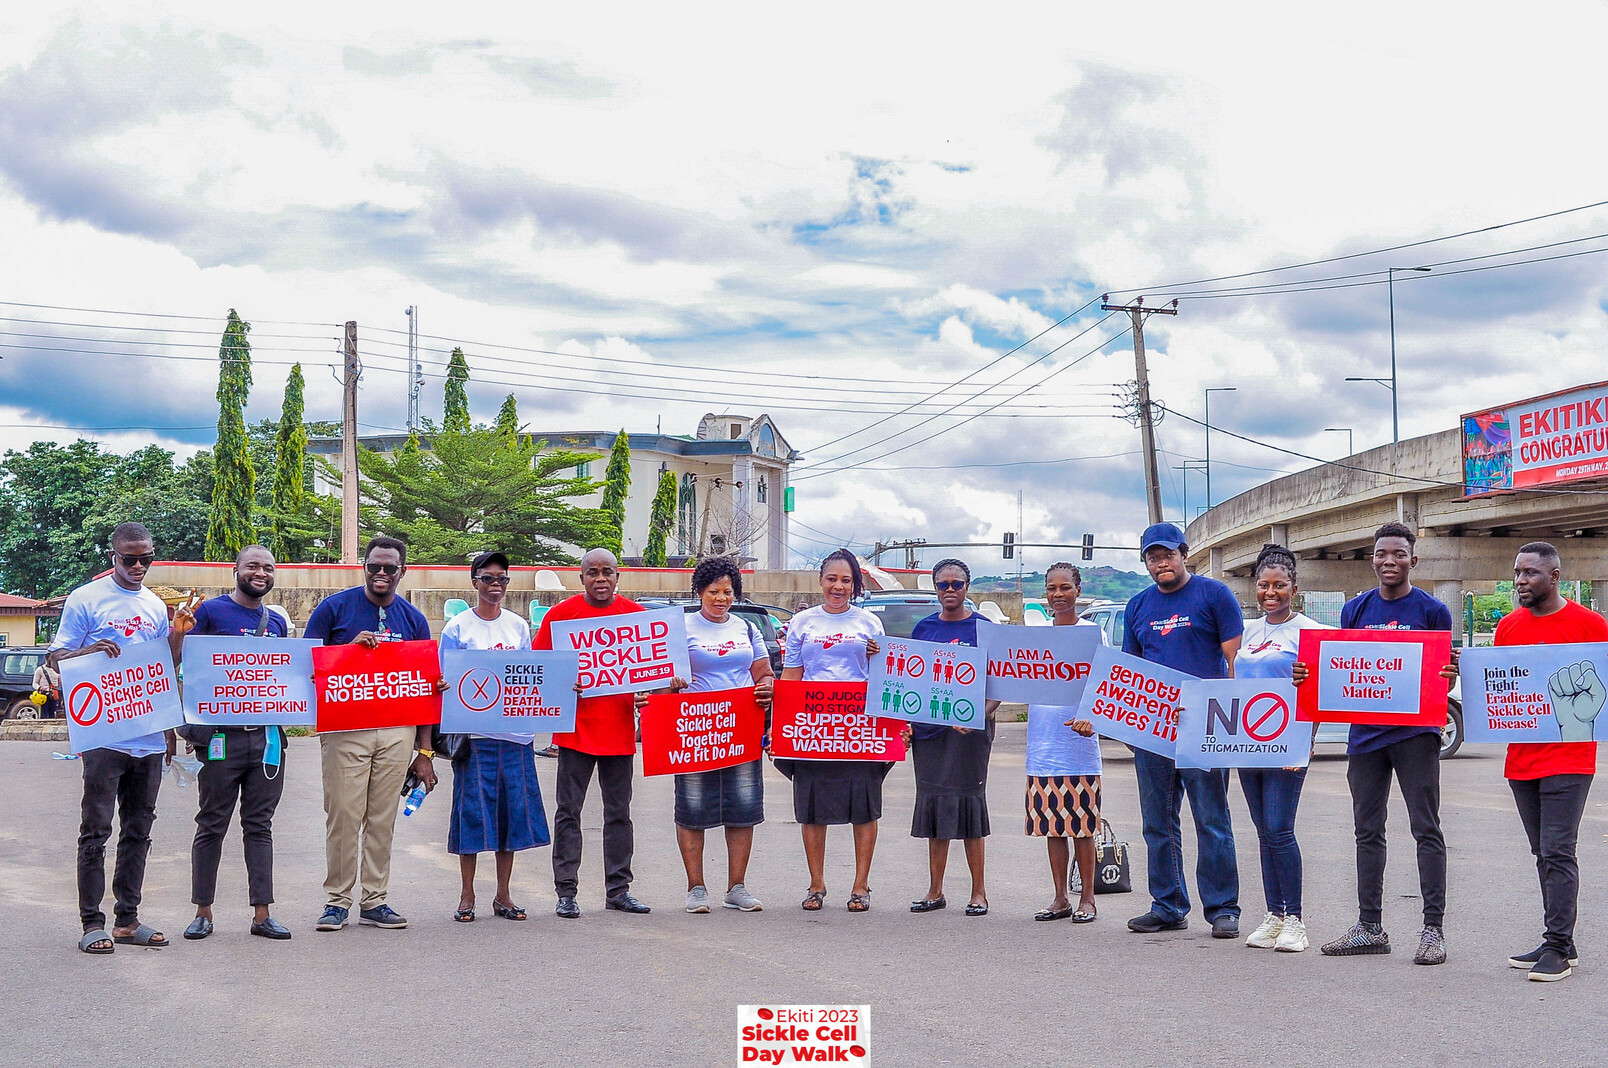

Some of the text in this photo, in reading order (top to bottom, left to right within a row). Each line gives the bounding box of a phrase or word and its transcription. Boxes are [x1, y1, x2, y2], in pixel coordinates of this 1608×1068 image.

[1519, 397, 1608, 439] EKITIK
[569, 621, 669, 649] WORLD
[887, 643, 907, 651] SS+SS
[934, 650, 956, 658] AS+AS
[212, 654, 291, 666] EMPOWER
[579, 642, 668, 670] SICKLE
[1008, 648, 1054, 661] I AM A
[504, 665, 544, 674] SICKLE
[1330, 657, 1402, 671] Sickle Cell
[126, 666, 144, 683] no
[148, 662, 164, 678] to
[225, 669, 277, 683] YASEF,
[327, 670, 426, 689] SICKLE CELL
[578, 667, 628, 689] DAY
[633, 666, 671, 679] JUNE 19
[1350, 672, 1386, 685] Lives
[1484, 666, 1529, 681] Join the
[504, 676, 544, 685] CELL IS
[883, 680, 904, 689] AS+AA
[1485, 679, 1519, 694] Fight:
[214, 685, 288, 698] PROTECT
[325, 683, 432, 703] NO BE CURSE!
[504, 686, 540, 696] NOT A
[805, 691, 825, 700] NO
[931, 687, 954, 696] SS+AA
[1342, 685, 1392, 700] Matter!
[1486, 692, 1544, 704] Eradicate
[198, 700, 307, 714] FUTURE PIKIN!
[503, 697, 542, 706] DEATH
[804, 703, 824, 712] NO
[502, 707, 561, 717] SENTENCE
[680, 701, 732, 717] Conquer
[1487, 703, 1551, 717] Sickle Cell
[676, 712, 736, 733] Sickle Cell
[795, 712, 878, 727] SUPPORT
[1488, 717, 1538, 729] Disease!
[679, 731, 734, 749] Together
[782, 725, 894, 741] SICKLE CELL
[792, 739, 886, 754] WARRIORS
[1201, 744, 1288, 753] STIGMATIZATION
[668, 743, 745, 765] We Fit Do Am
